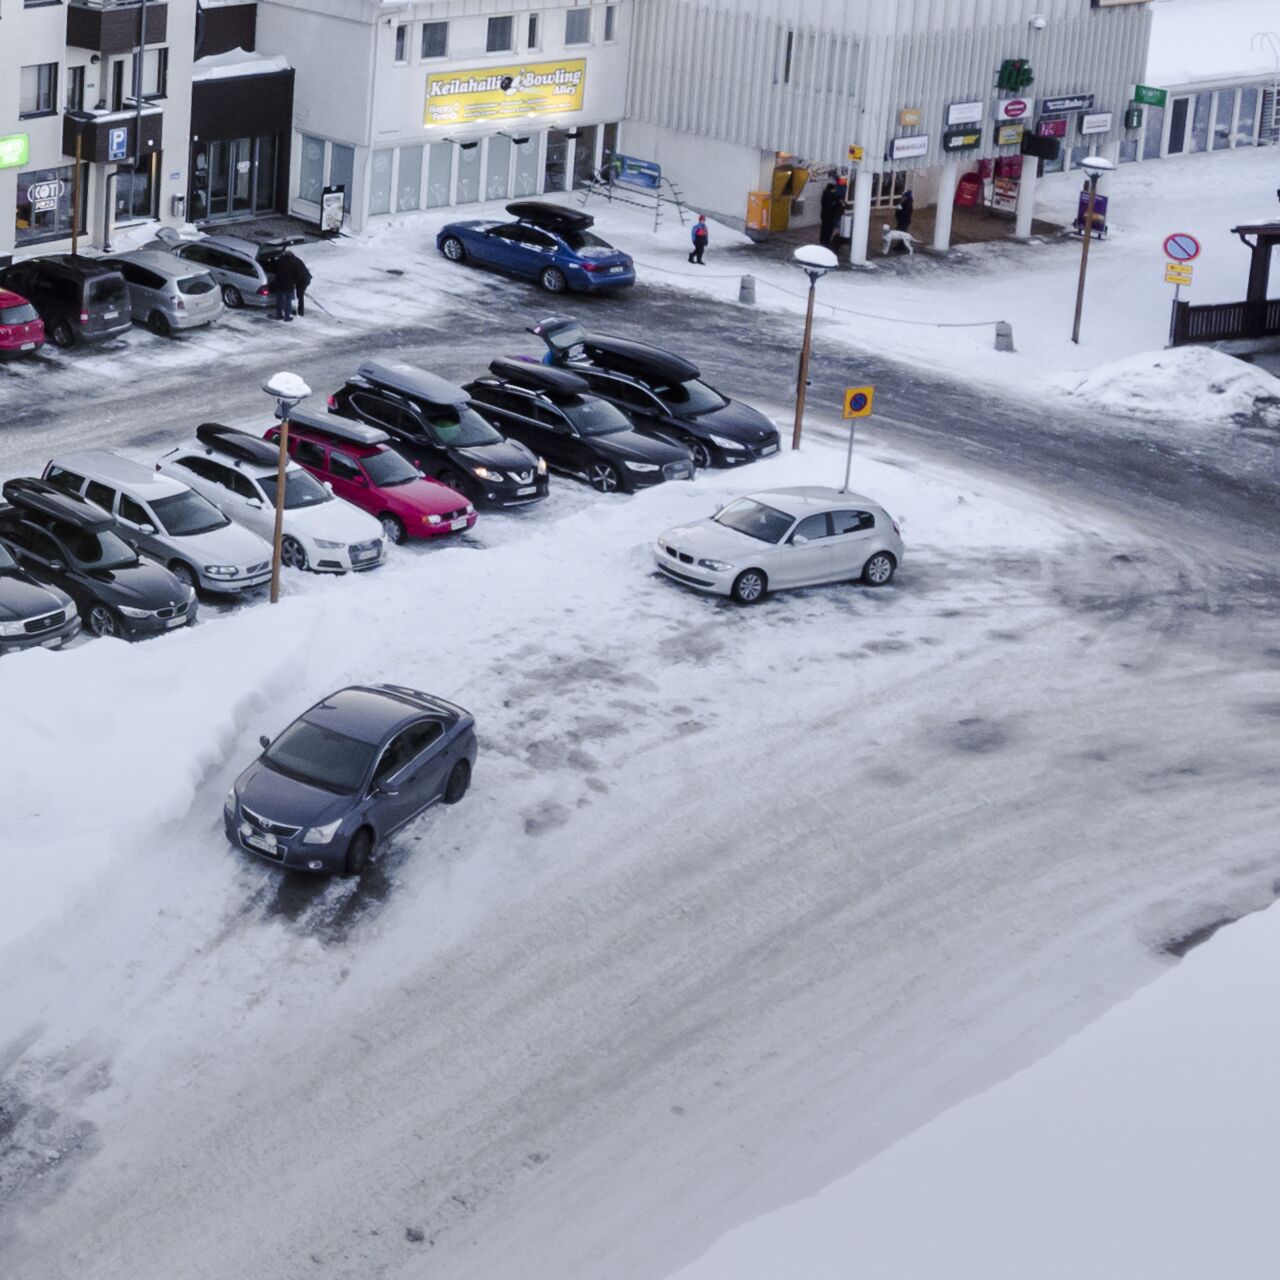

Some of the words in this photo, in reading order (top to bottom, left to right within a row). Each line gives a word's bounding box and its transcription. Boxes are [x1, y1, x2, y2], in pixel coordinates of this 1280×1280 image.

[429, 75, 502, 96] Keilahalli
[525, 69, 582, 87] Bowling
[552, 85, 577, 96] Alley
[113, 130, 125, 150] P
